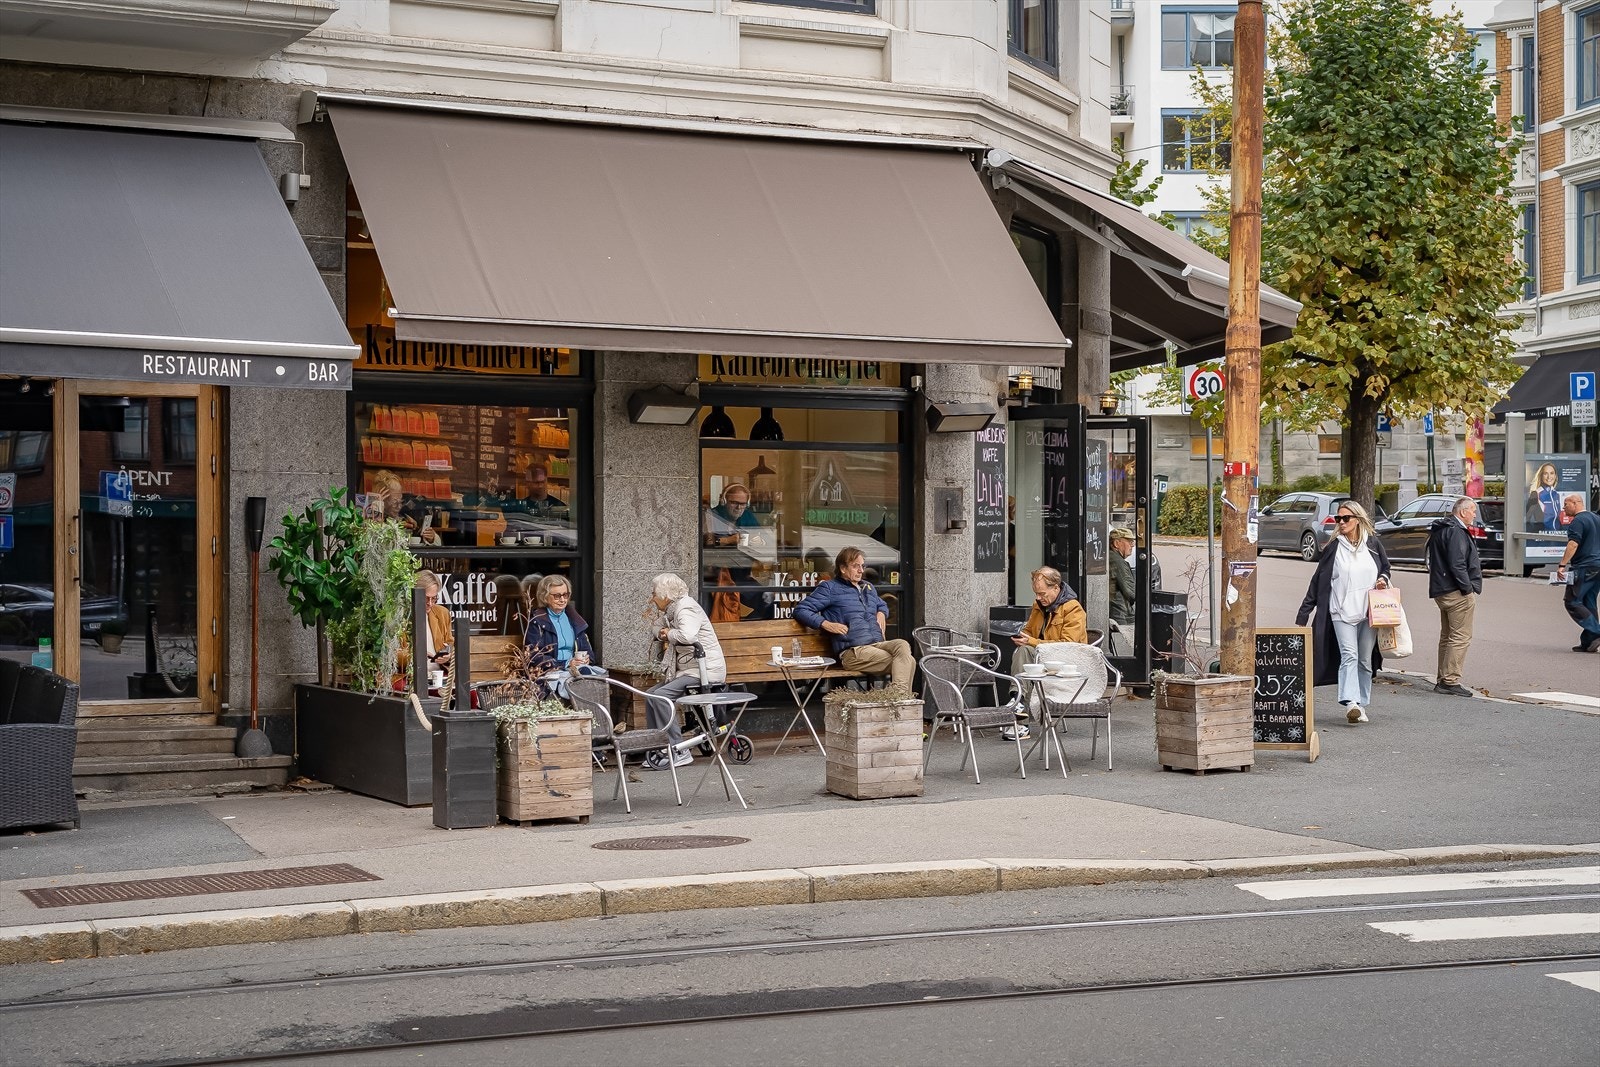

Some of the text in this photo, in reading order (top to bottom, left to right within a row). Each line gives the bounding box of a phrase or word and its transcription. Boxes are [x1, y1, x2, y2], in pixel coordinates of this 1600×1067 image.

[143, 354, 339, 382] RESTAURANT BAR
[1197, 376, 1221, 396] 30
[1576, 376, 1590, 398] P
[1377, 415, 1388, 430] P
[982, 447, 999, 462] KAFFE
[117, 464, 173, 486] ÅPENT
[1161, 482, 1166, 490] P
[436, 572, 498, 606] Kaffe
[774, 571, 826, 602] Kaff
[449, 606, 498, 623] enneriet
[1254, 674, 1297, 697] 25%
[1254, 700, 1289, 712] ABATT PÅ
[1269, 714, 1304, 724] BAKEVARER
